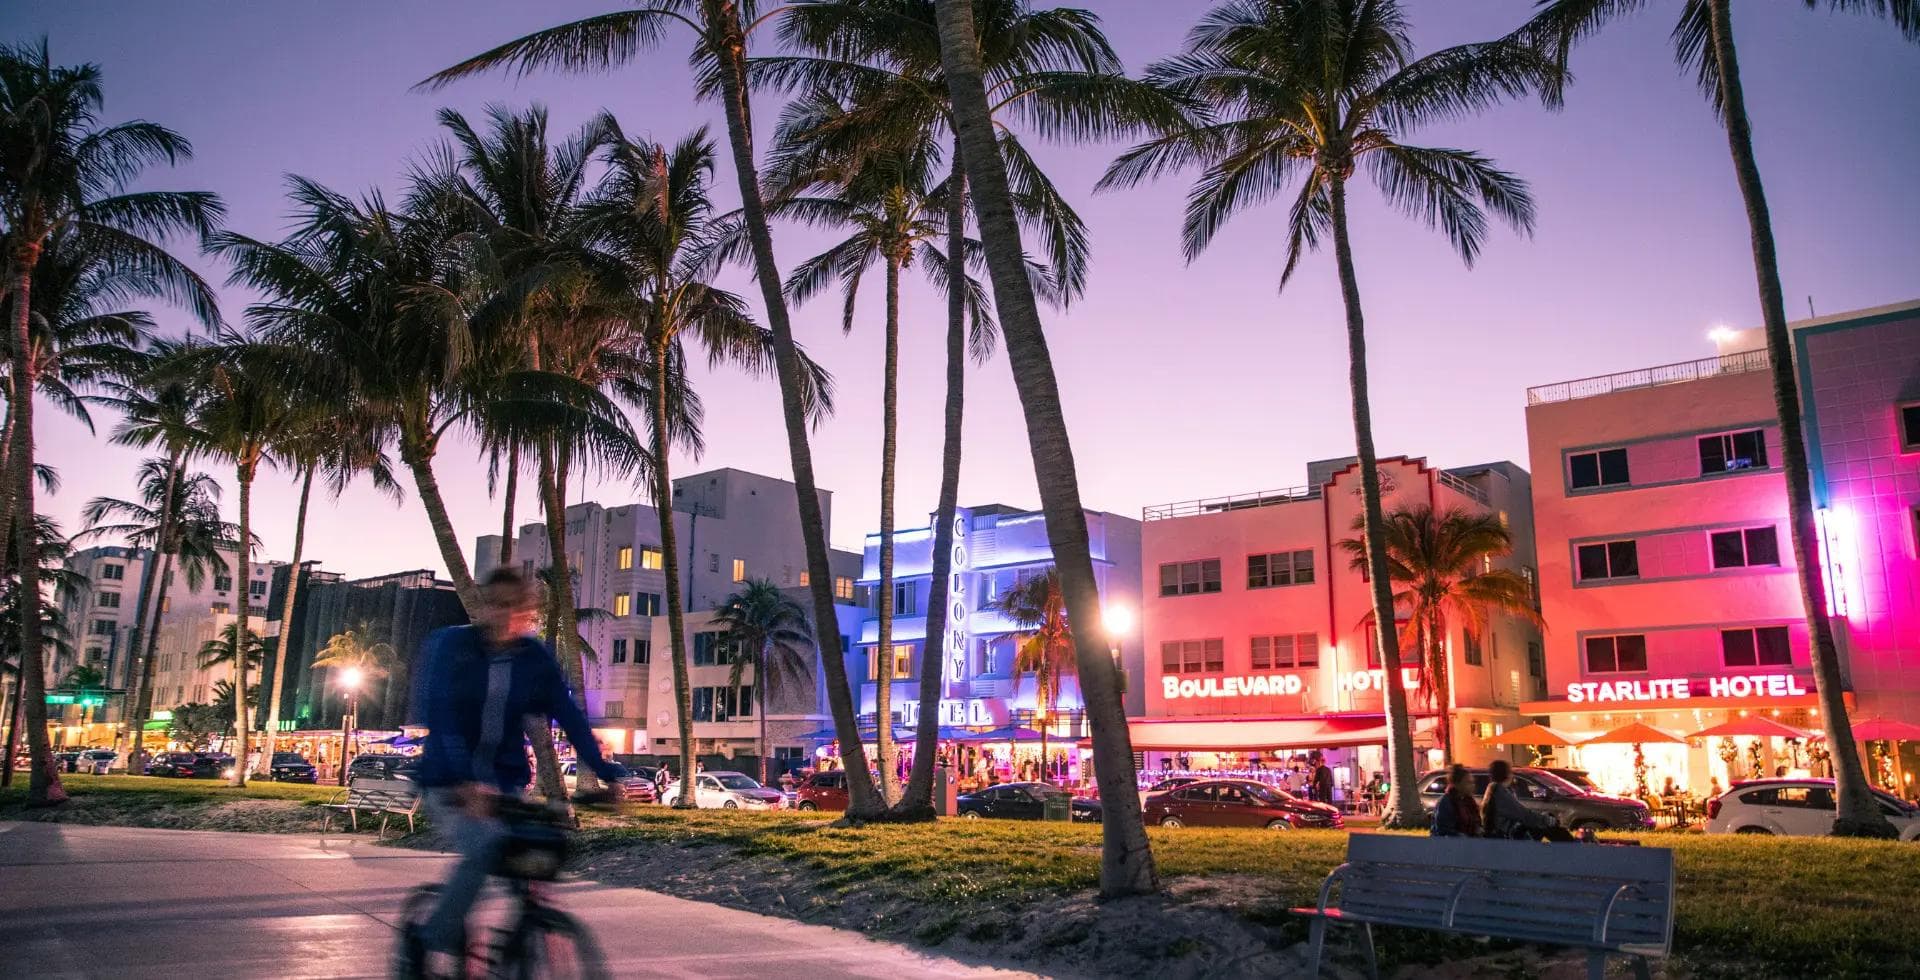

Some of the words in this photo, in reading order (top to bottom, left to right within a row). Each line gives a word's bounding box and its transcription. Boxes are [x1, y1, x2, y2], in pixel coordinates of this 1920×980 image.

[952, 516, 967, 680] COLONY
[1162, 675, 1302, 699] BOULEVARD
[1337, 668, 1421, 691] HOTL
[1567, 678, 1690, 702] STARLITE
[1709, 674, 1806, 697] HOTEL
[902, 702, 992, 723] HEL
